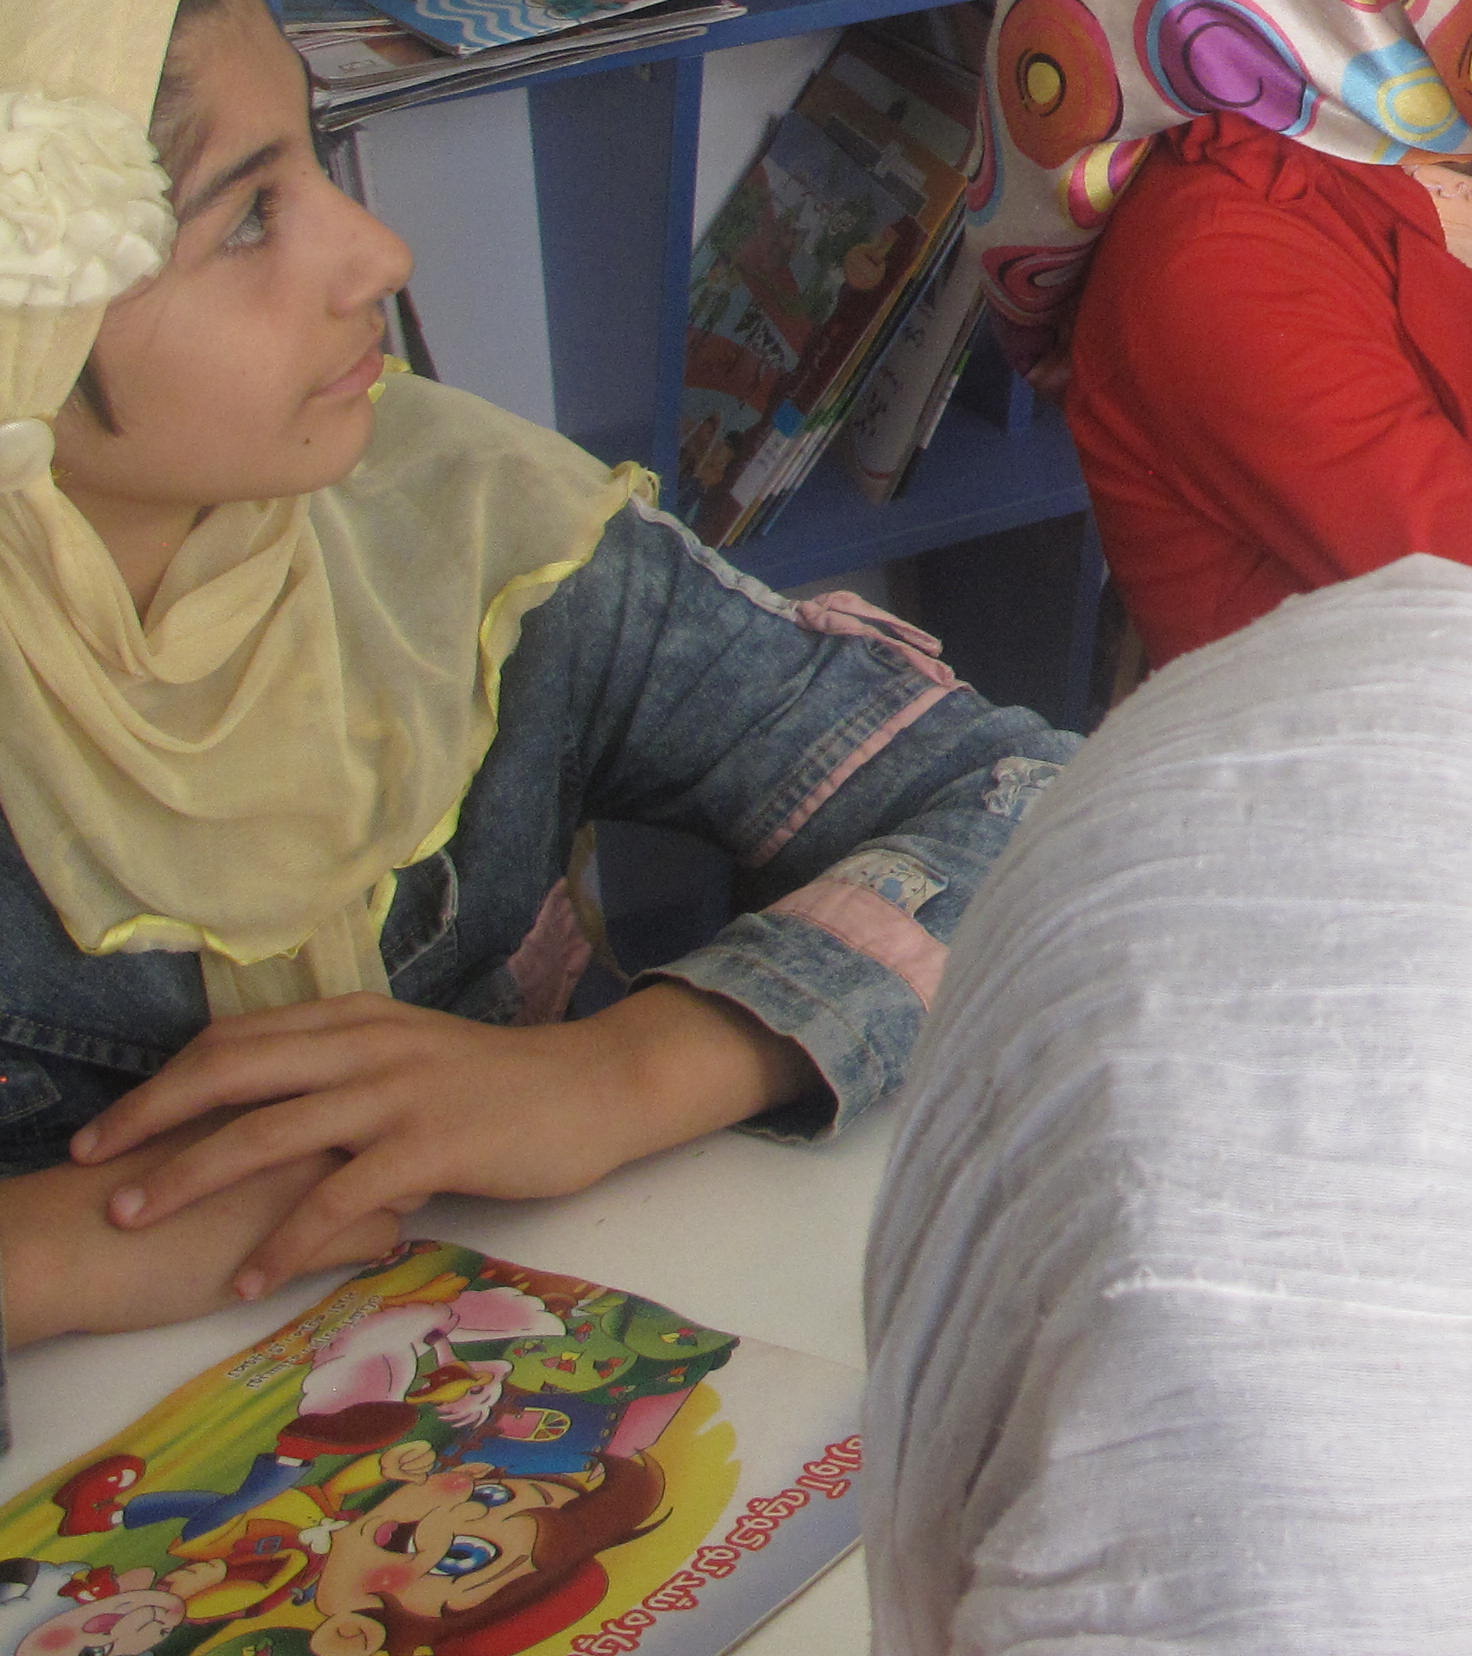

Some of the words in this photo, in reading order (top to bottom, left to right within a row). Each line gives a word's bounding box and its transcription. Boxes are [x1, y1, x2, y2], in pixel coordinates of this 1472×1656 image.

[642, 1570, 706, 1612] شد
[691, 1545, 741, 1580] تو
[725, 1488, 811, 1552] کوچه
